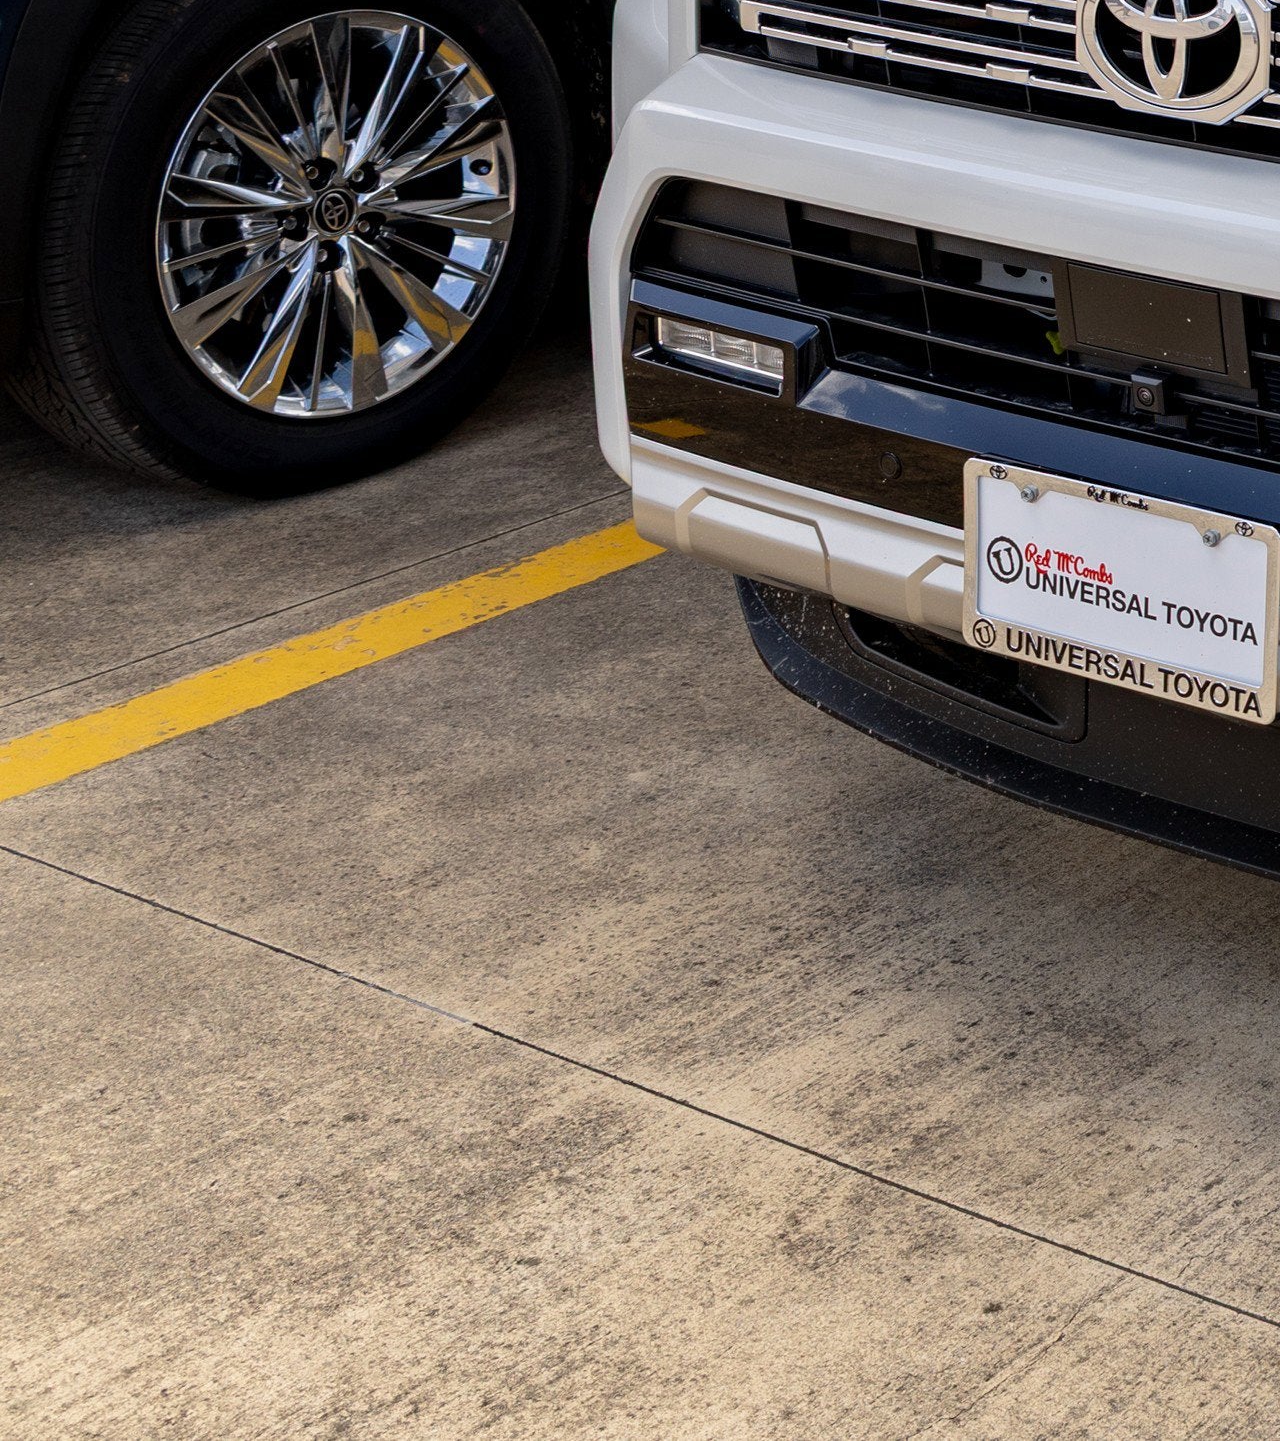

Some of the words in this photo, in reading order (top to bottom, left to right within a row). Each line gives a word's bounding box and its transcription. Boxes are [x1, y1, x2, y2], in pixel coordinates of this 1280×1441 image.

[1025, 543, 1051, 574] Red
[1053, 550, 1113, 585] McCombs
[1025, 566, 1157, 621] UNIVERSAL
[1161, 601, 1258, 646] TOYOTA
[1006, 627, 1154, 689] UNIVERSAL
[1157, 667, 1262, 717] TOYOTA
